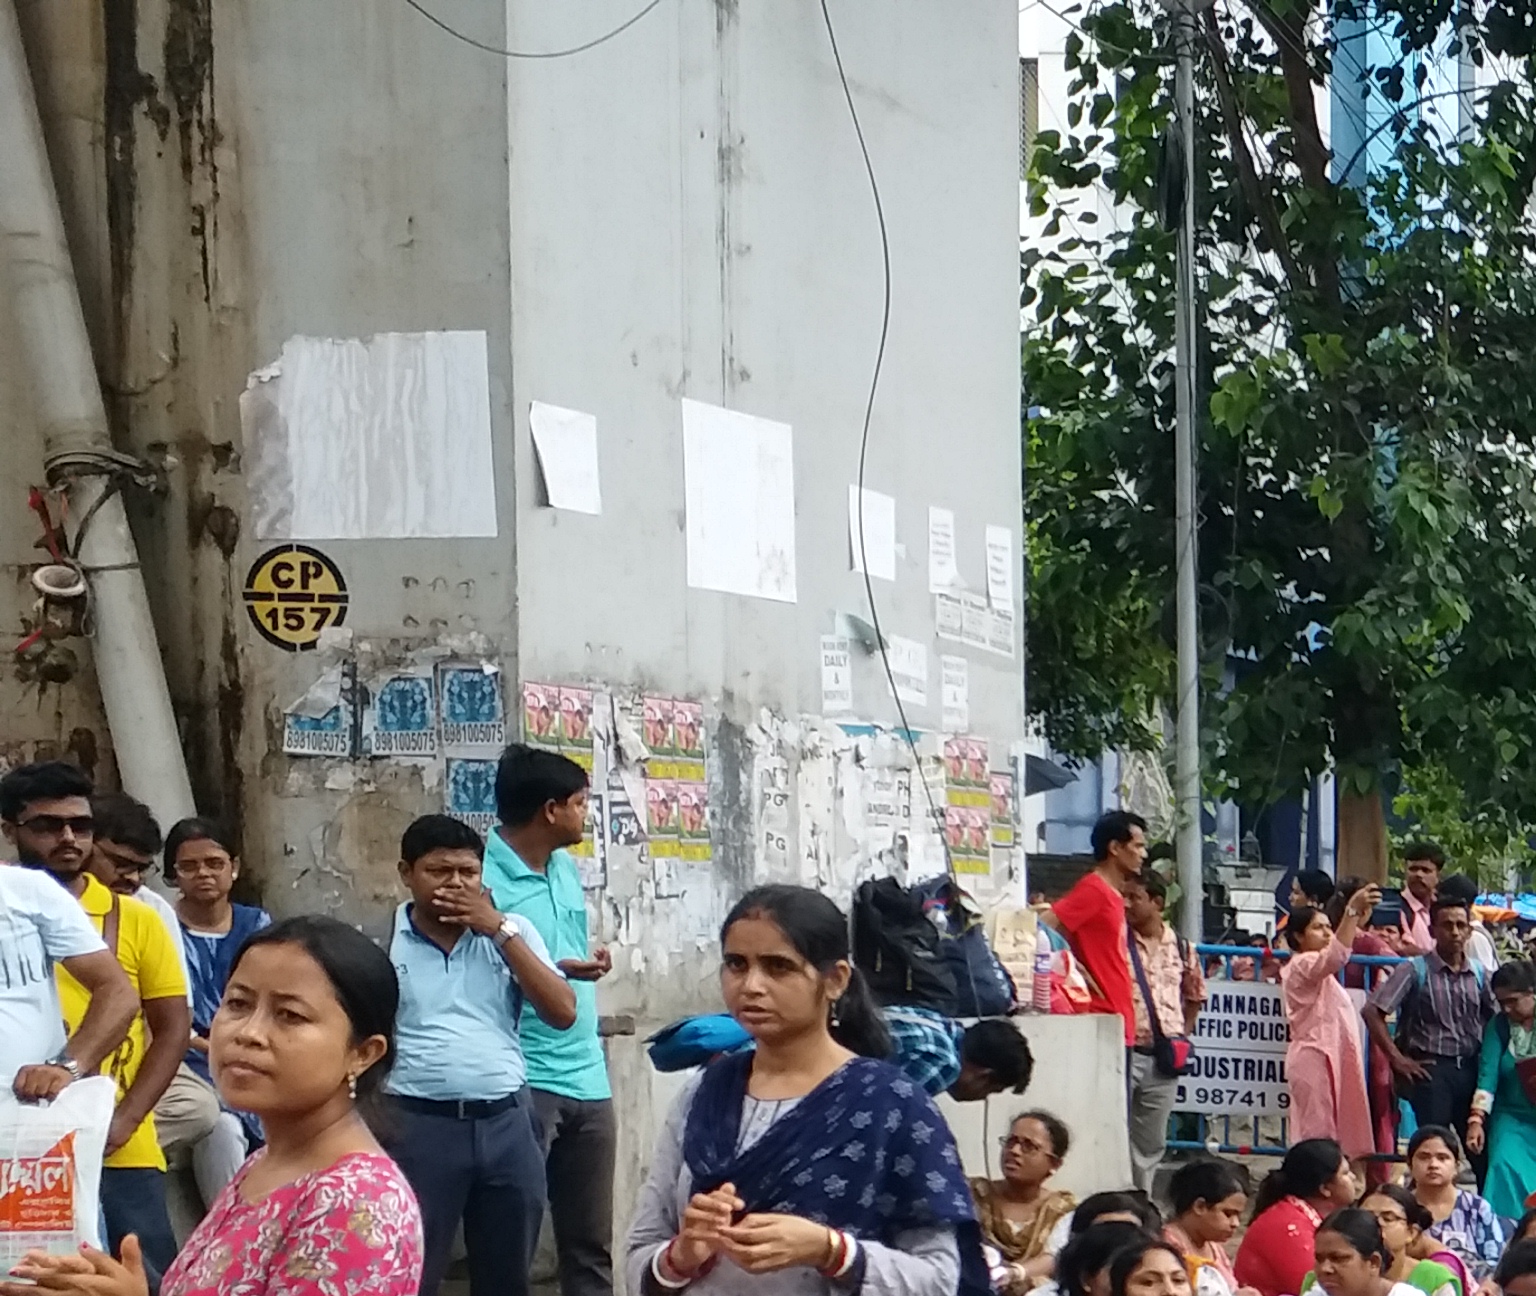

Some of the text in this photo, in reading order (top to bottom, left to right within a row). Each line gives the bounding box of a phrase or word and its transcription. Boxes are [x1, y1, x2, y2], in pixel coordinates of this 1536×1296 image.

[270, 561, 324, 590] CP
[265, 607, 331, 633] 157
[824, 654, 848, 668] DAILY
[286, 732, 347, 752] 8981005075
[374, 732, 435, 751] 8981005075
[443, 722, 503, 743] 8981005075
[766, 832, 786, 851] PG
[1200, 993, 1287, 1019] ANNAGA
[1192, 1018, 1232, 1039] FFIC
[1189, 1055, 1289, 1083] DUSTRIAL
[1195, 1087, 1291, 1109] 98741 9
